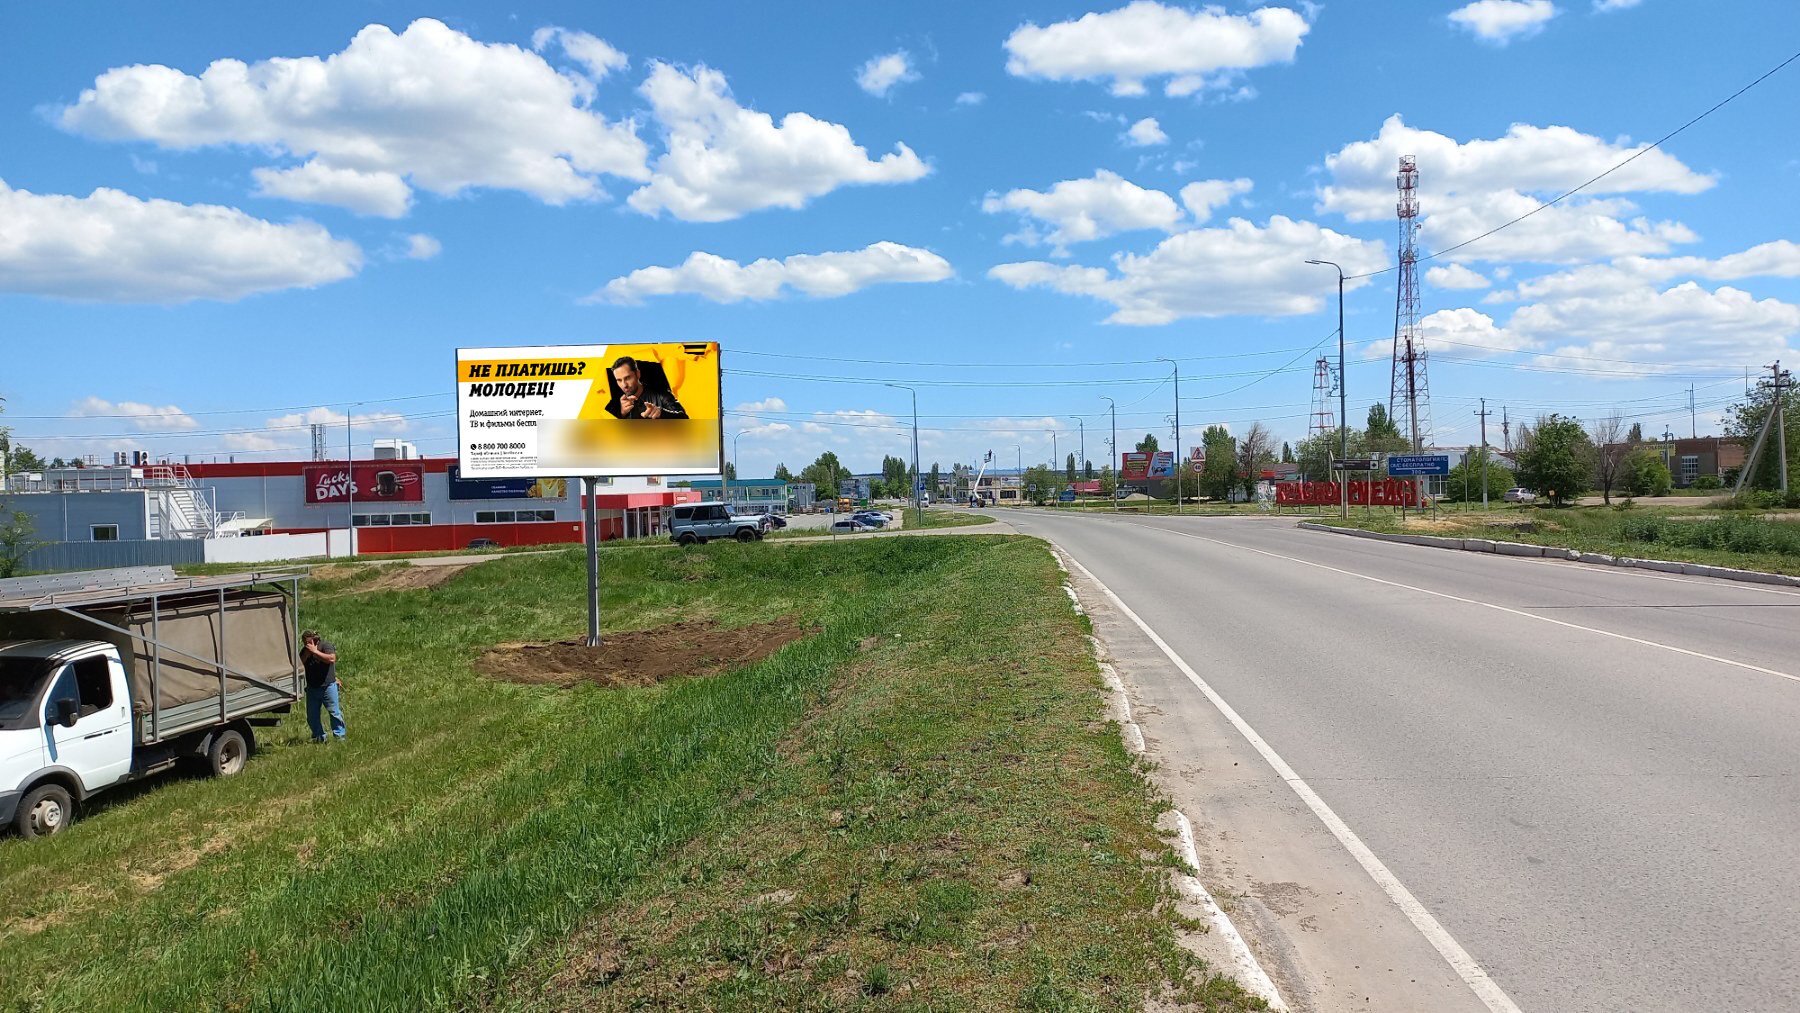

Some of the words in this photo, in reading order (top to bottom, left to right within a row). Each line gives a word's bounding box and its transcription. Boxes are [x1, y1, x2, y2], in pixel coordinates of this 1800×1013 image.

[469, 364, 492, 378] НЕ
[495, 361, 586, 377] ПЛАТИШЬ?
[469, 382, 555, 399] МОЛОДЕЦ!
[469, 409, 508, 418] Домашний
[508, 408, 544, 417] интернет,
[470, 420, 478, 428] ТВ
[486, 420, 515, 429] фильмы
[316, 471, 351, 488] Lucky
[316, 481, 358, 500] DAYS
